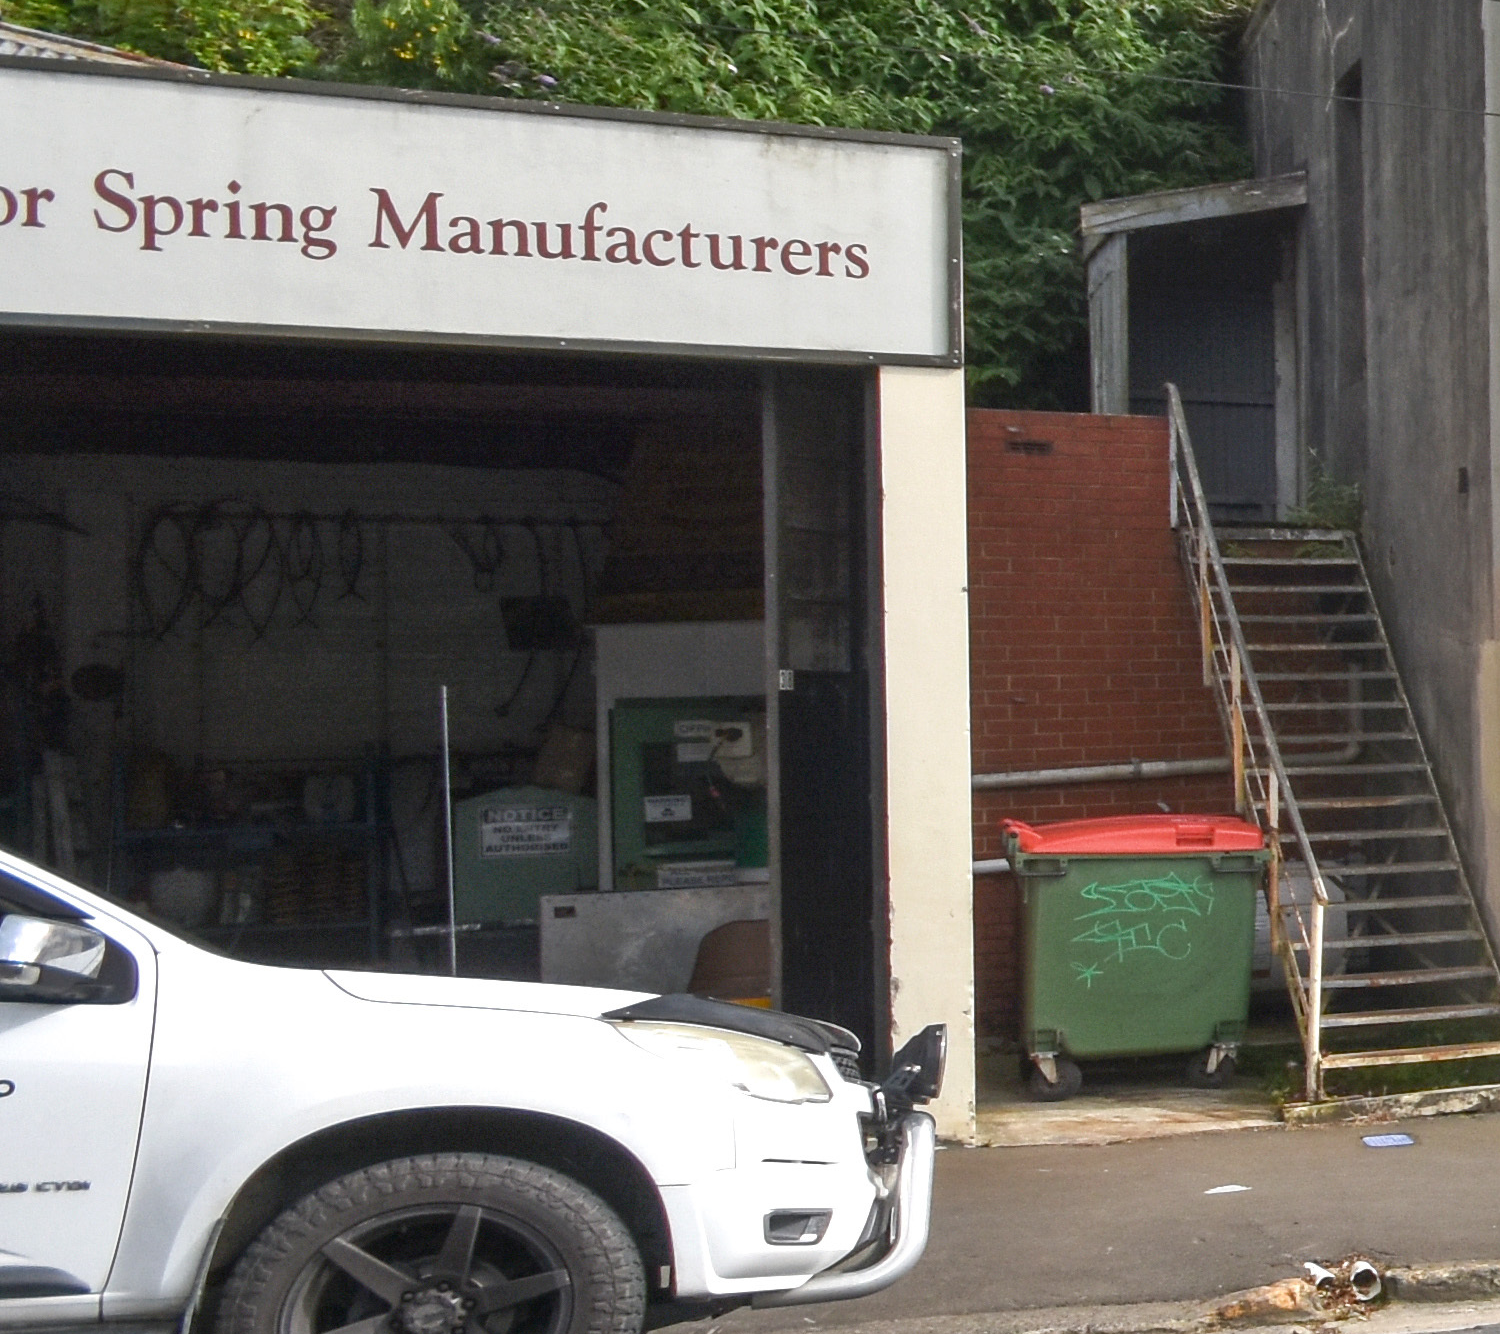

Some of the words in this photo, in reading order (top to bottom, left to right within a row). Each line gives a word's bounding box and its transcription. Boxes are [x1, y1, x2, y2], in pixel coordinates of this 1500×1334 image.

[93, 167, 339, 262] Spring
[368, 186, 871, 280] Manufacturers
[486, 808, 566, 822] NOTICE
